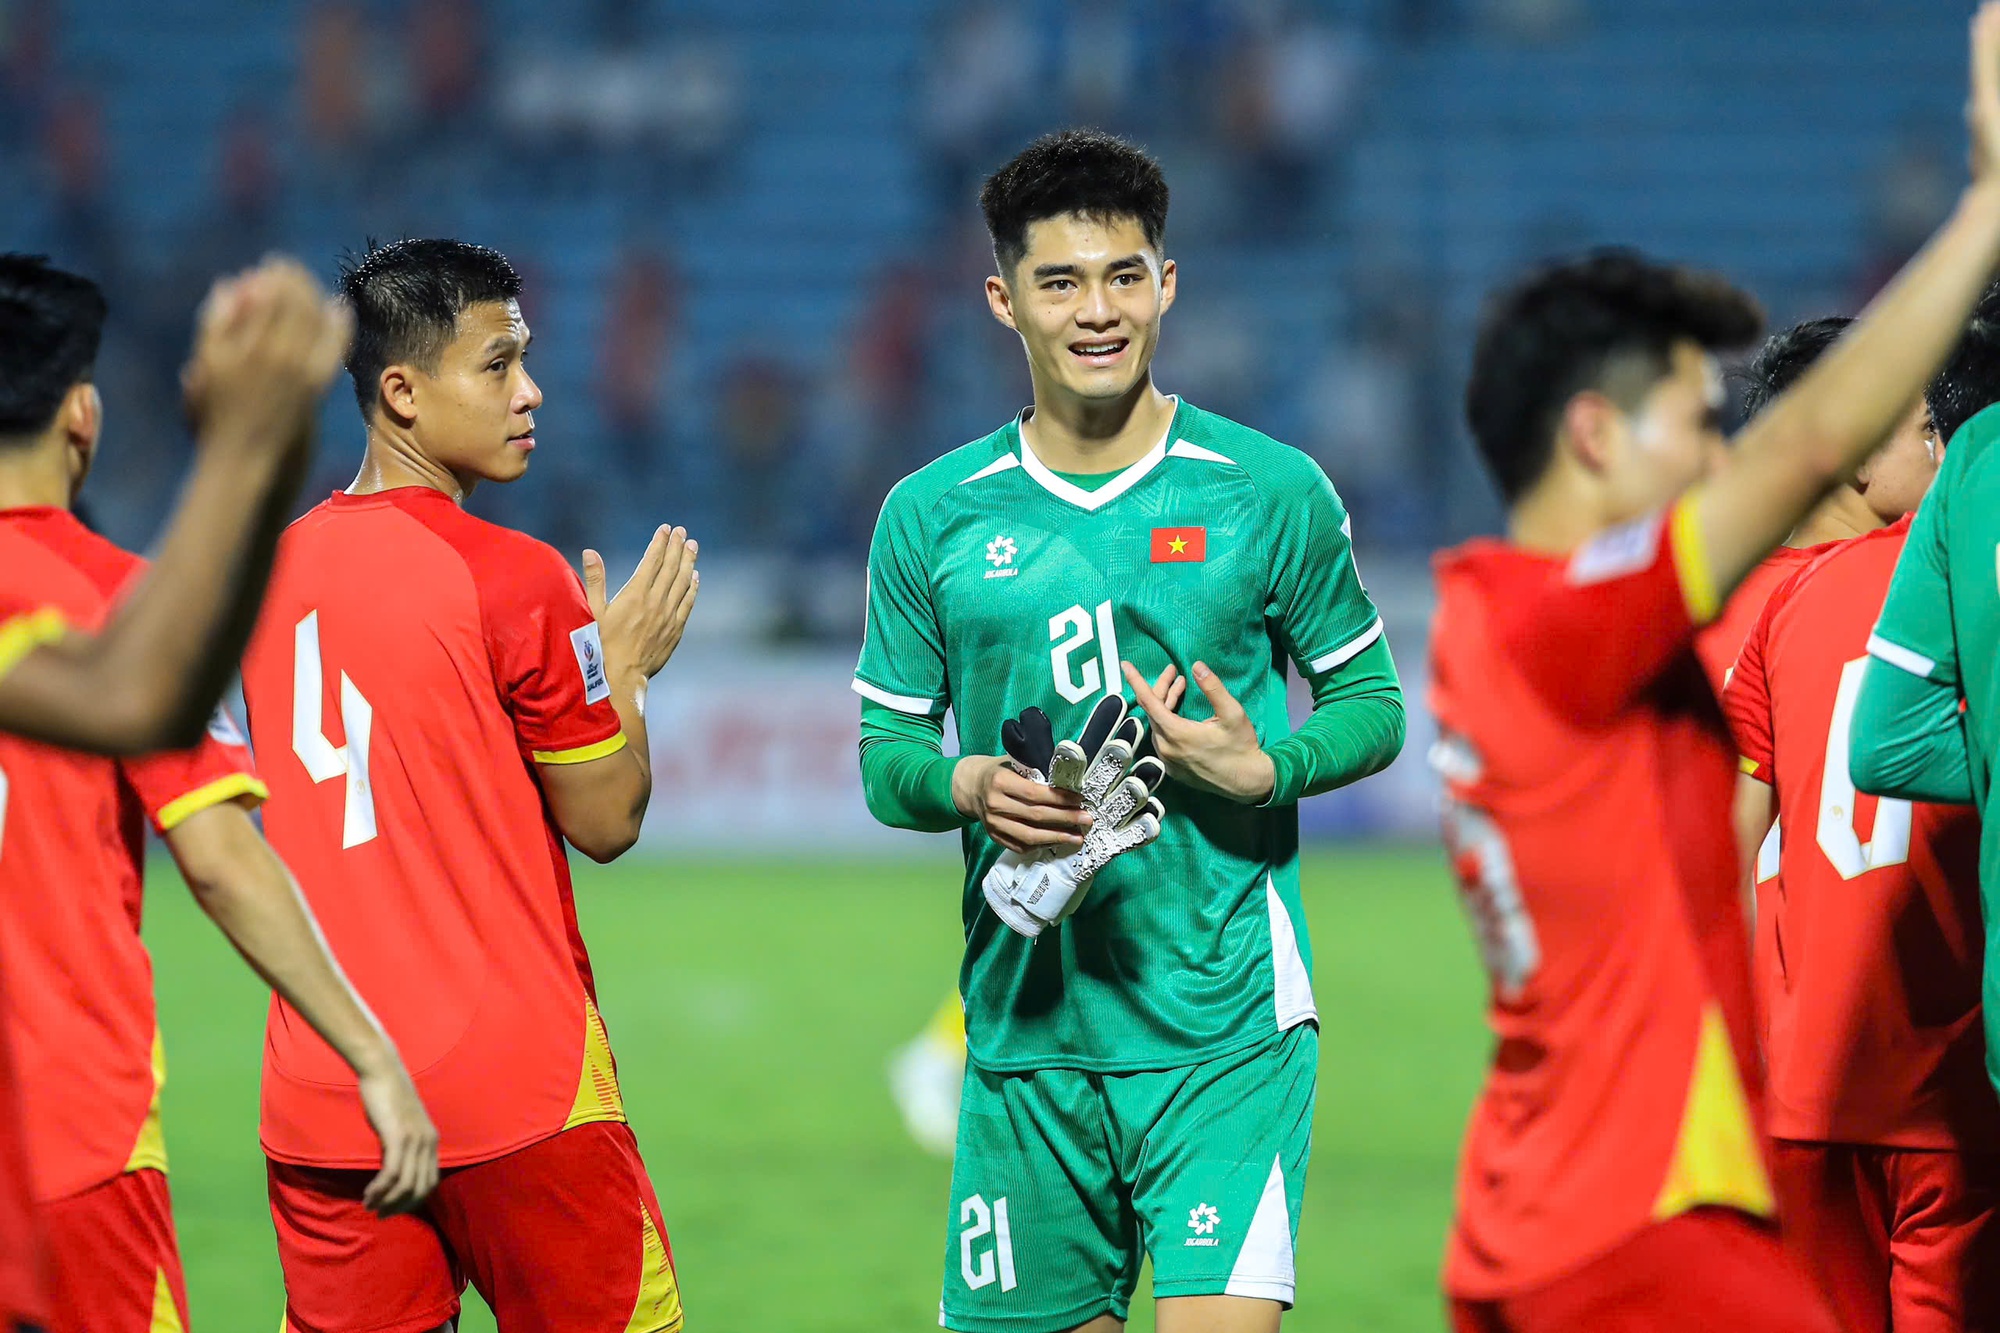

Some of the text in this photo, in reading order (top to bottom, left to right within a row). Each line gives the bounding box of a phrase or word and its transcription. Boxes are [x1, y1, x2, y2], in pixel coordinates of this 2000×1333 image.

[1048, 598, 1123, 705] 21
[292, 608, 378, 850] 4
[960, 1193, 1018, 1293] 21
